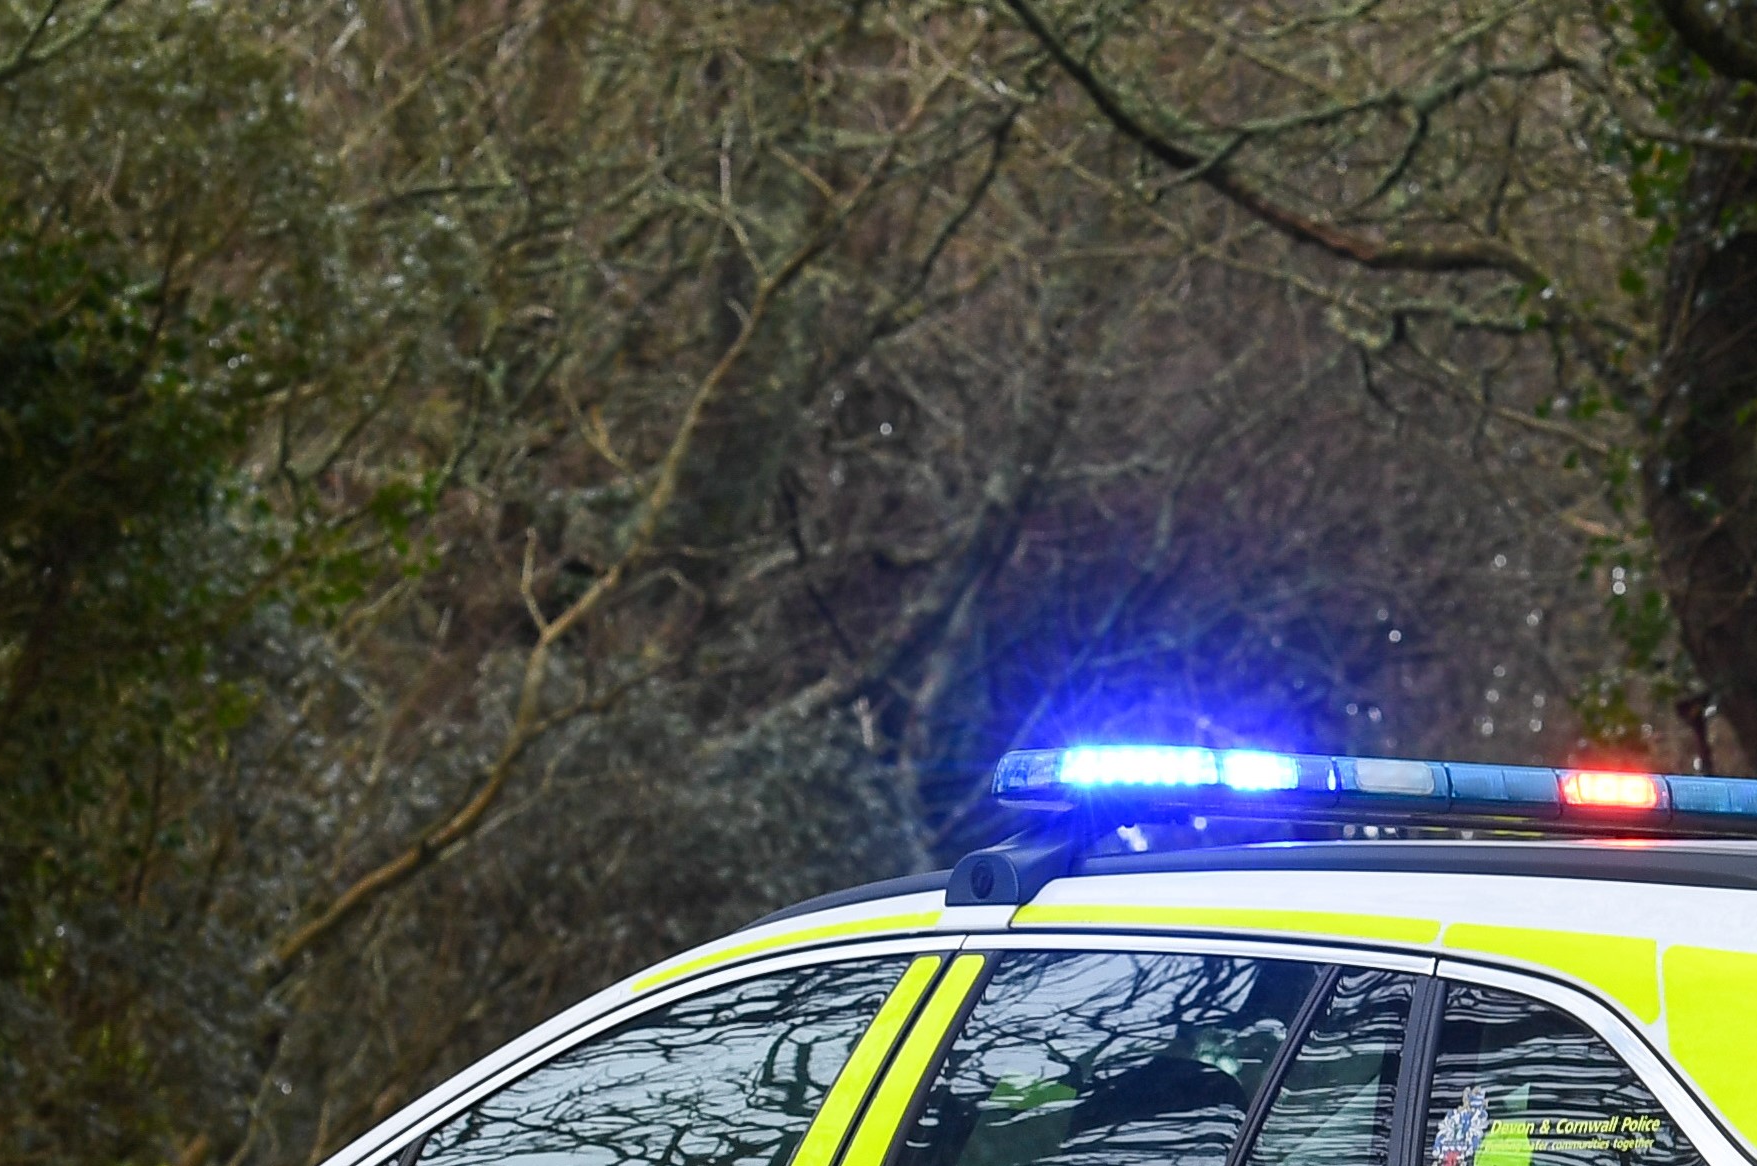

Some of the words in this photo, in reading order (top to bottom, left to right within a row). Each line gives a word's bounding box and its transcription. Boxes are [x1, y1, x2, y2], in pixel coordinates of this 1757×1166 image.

[1490, 1119, 1535, 1135] Devon
[1539, 1118, 1551, 1135] &
[1556, 1115, 1618, 1134] Cornwall
[1621, 1114, 1661, 1132] Police
[1613, 1136, 1655, 1152] together
